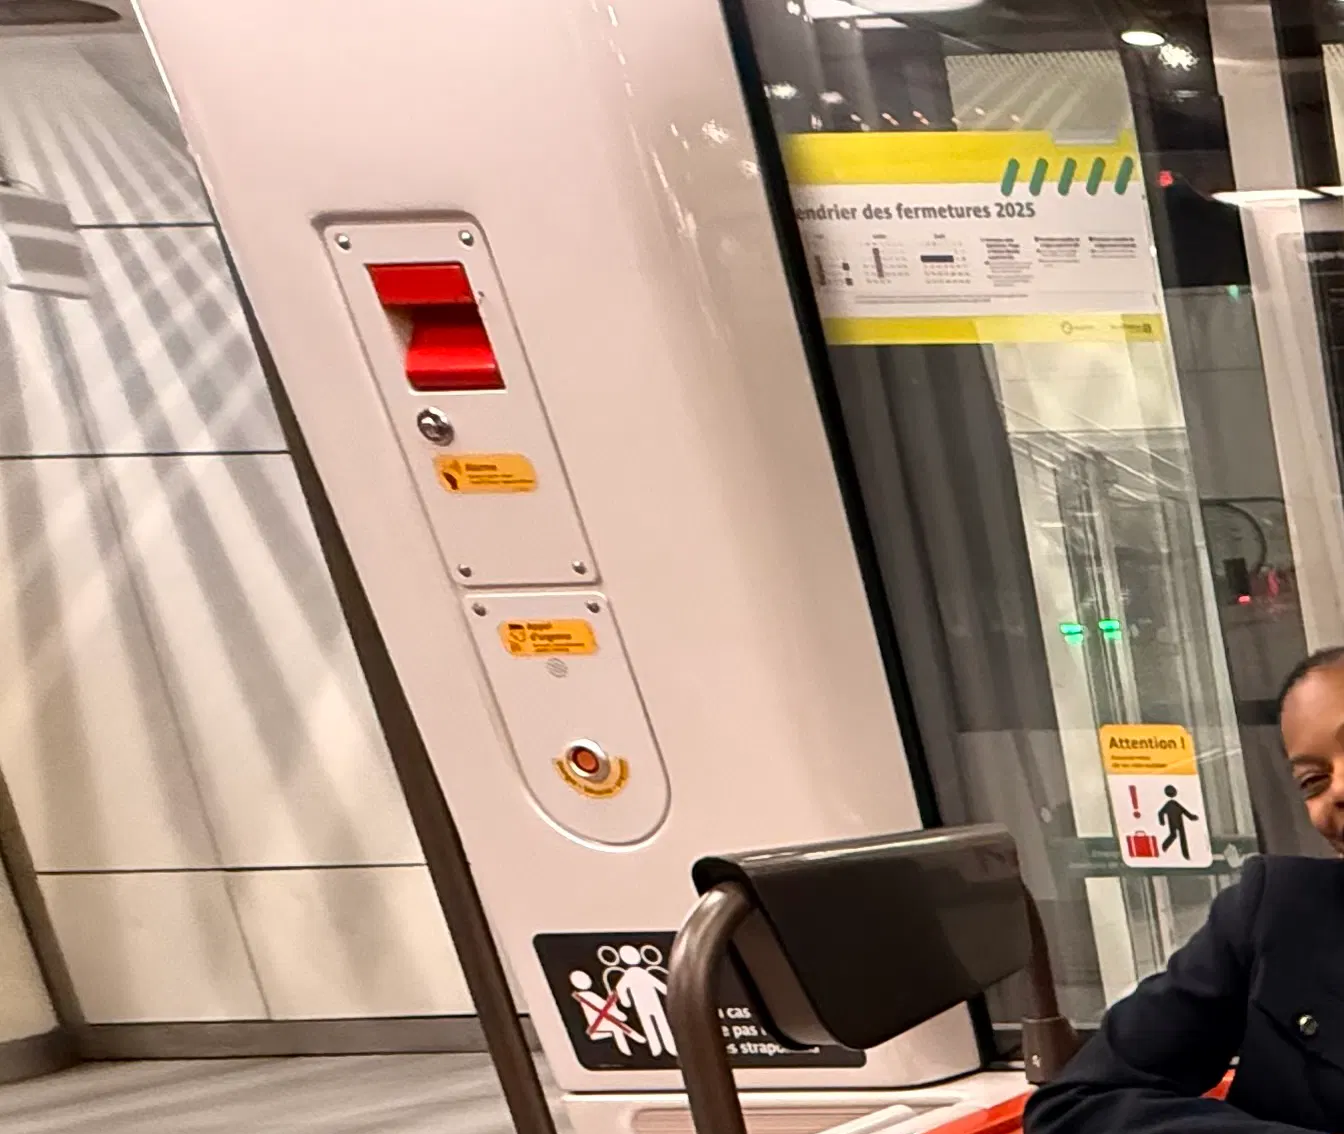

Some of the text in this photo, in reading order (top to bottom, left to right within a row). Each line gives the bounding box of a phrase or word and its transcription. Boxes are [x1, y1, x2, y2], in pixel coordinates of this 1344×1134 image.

[797, 202, 1036, 221] endrier des fermetures 2025
[1109, 735, 1177, 751] Attention
[726, 1007, 752, 1019] cas
[732, 1025, 759, 1039] pas
